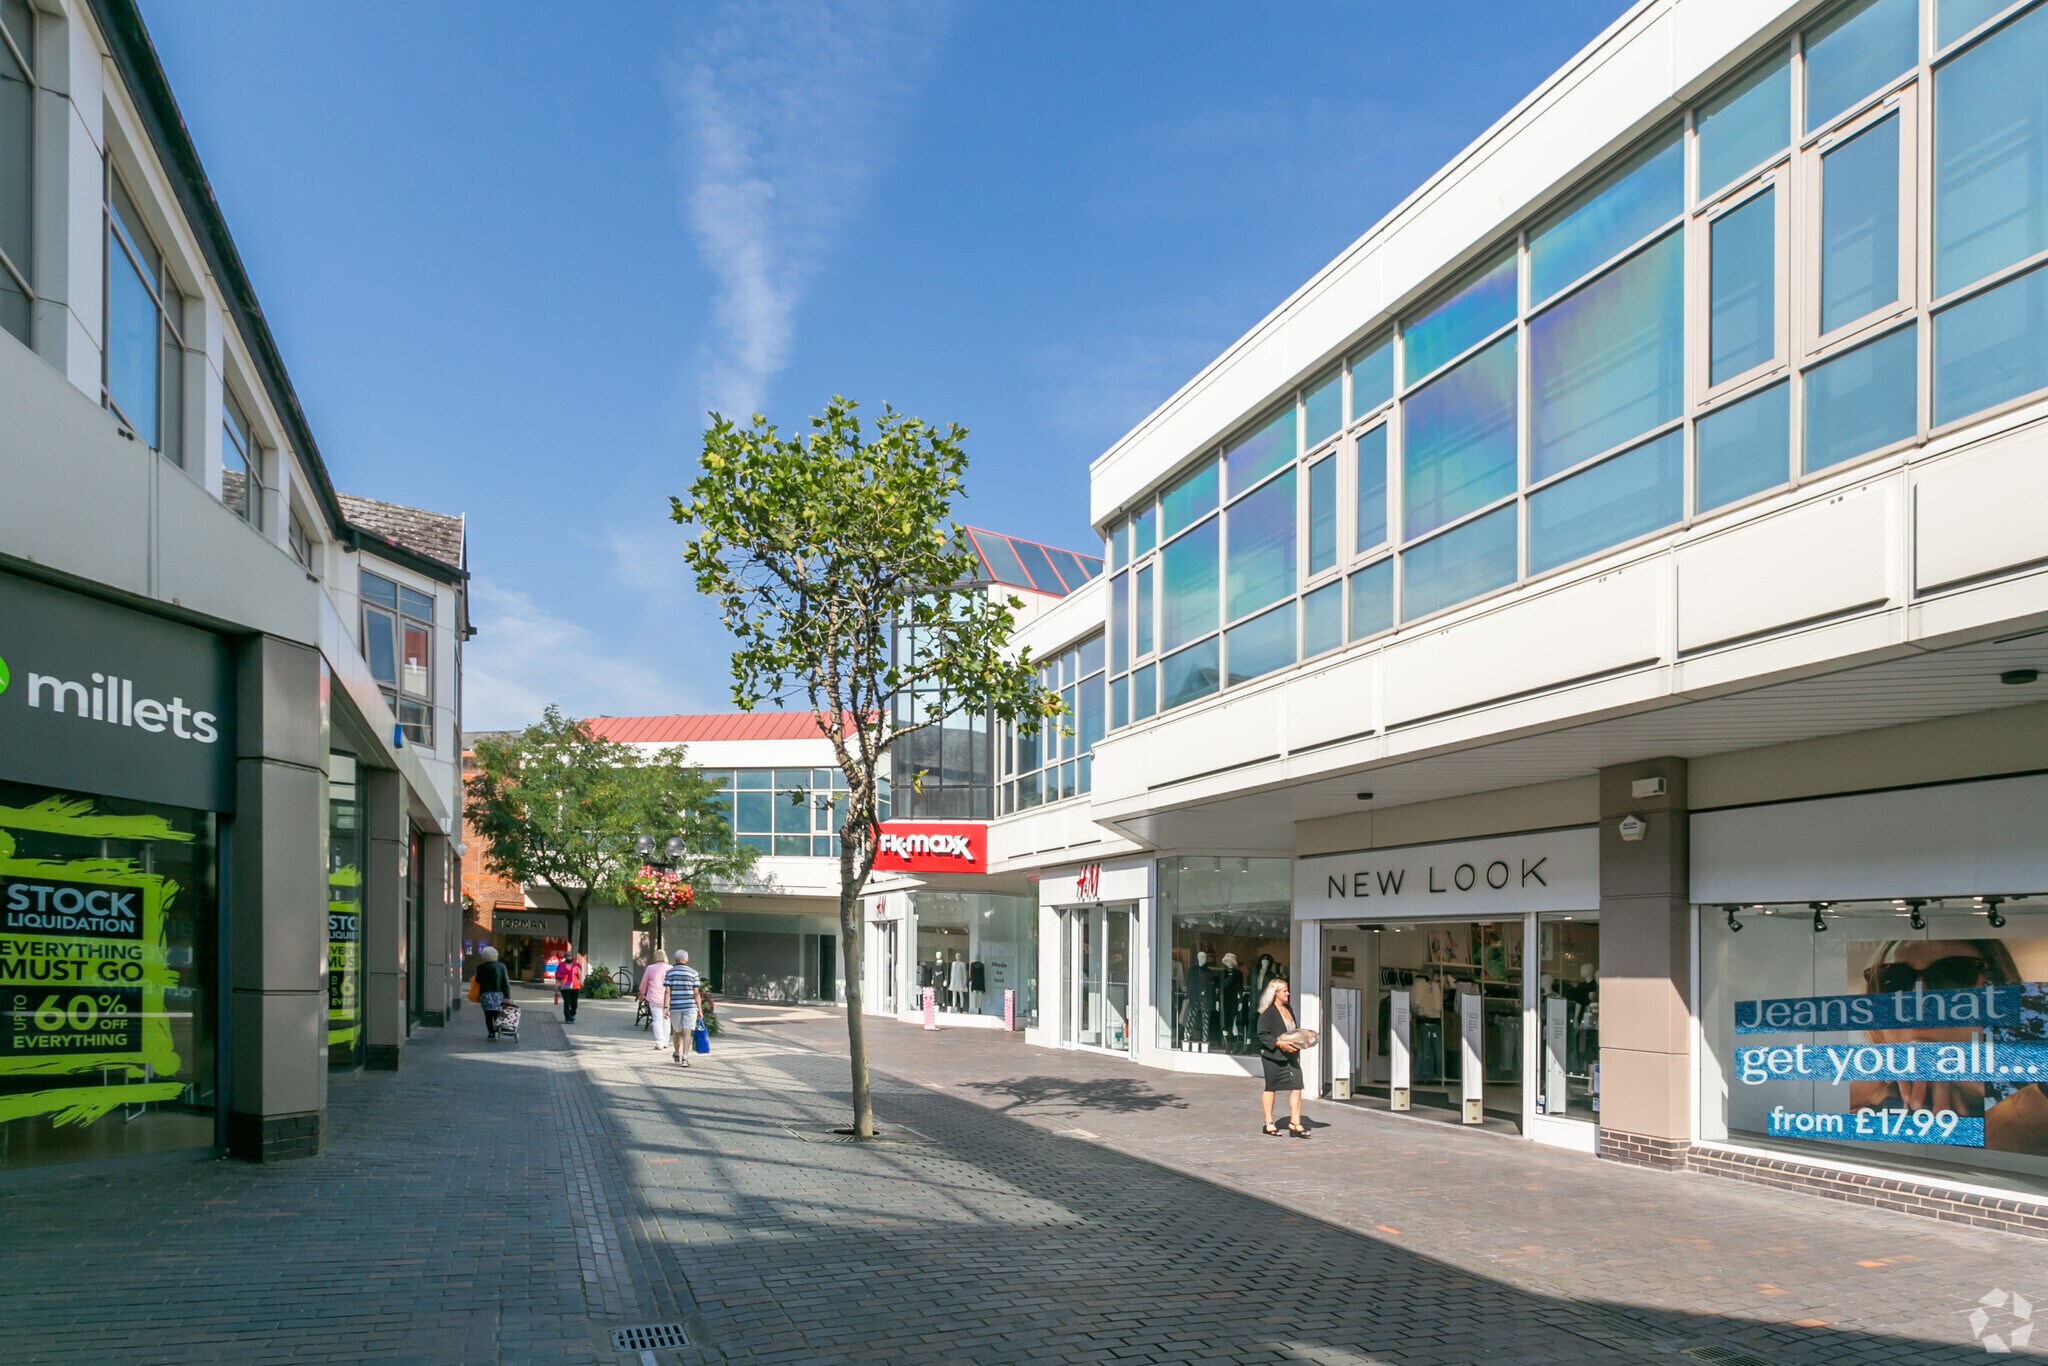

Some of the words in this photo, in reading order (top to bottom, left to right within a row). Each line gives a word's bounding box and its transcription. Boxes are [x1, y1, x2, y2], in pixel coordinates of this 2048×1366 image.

[28, 672, 218, 744] millets
[1076, 863, 1100, 898] H&M
[1328, 868, 1405, 899] NEW
[1429, 857, 1548, 893] LOOK
[6, 883, 136, 918] STOCK
[7, 912, 135, 933] LIQUIDATION
[499, 918, 548, 930] TOPMAN
[0, 940, 143, 960] EVERYTHING
[0, 957, 88, 981] MUST
[97, 961, 144, 982] GO
[34, 994, 127, 1031] 60%
[1741, 999, 1874, 1028] Jeans
[1893, 981, 2006, 1023] that
[13, 1034, 128, 1048] EVERYTHING
[100, 1019, 128, 1030] OFF
[1742, 1043, 1812, 1085] get
[1826, 1046, 1916, 1086] you
[1936, 1031, 2038, 1075] all...
[1771, 1105, 1843, 1133] from
[1855, 1108, 1959, 1138] £17.99
